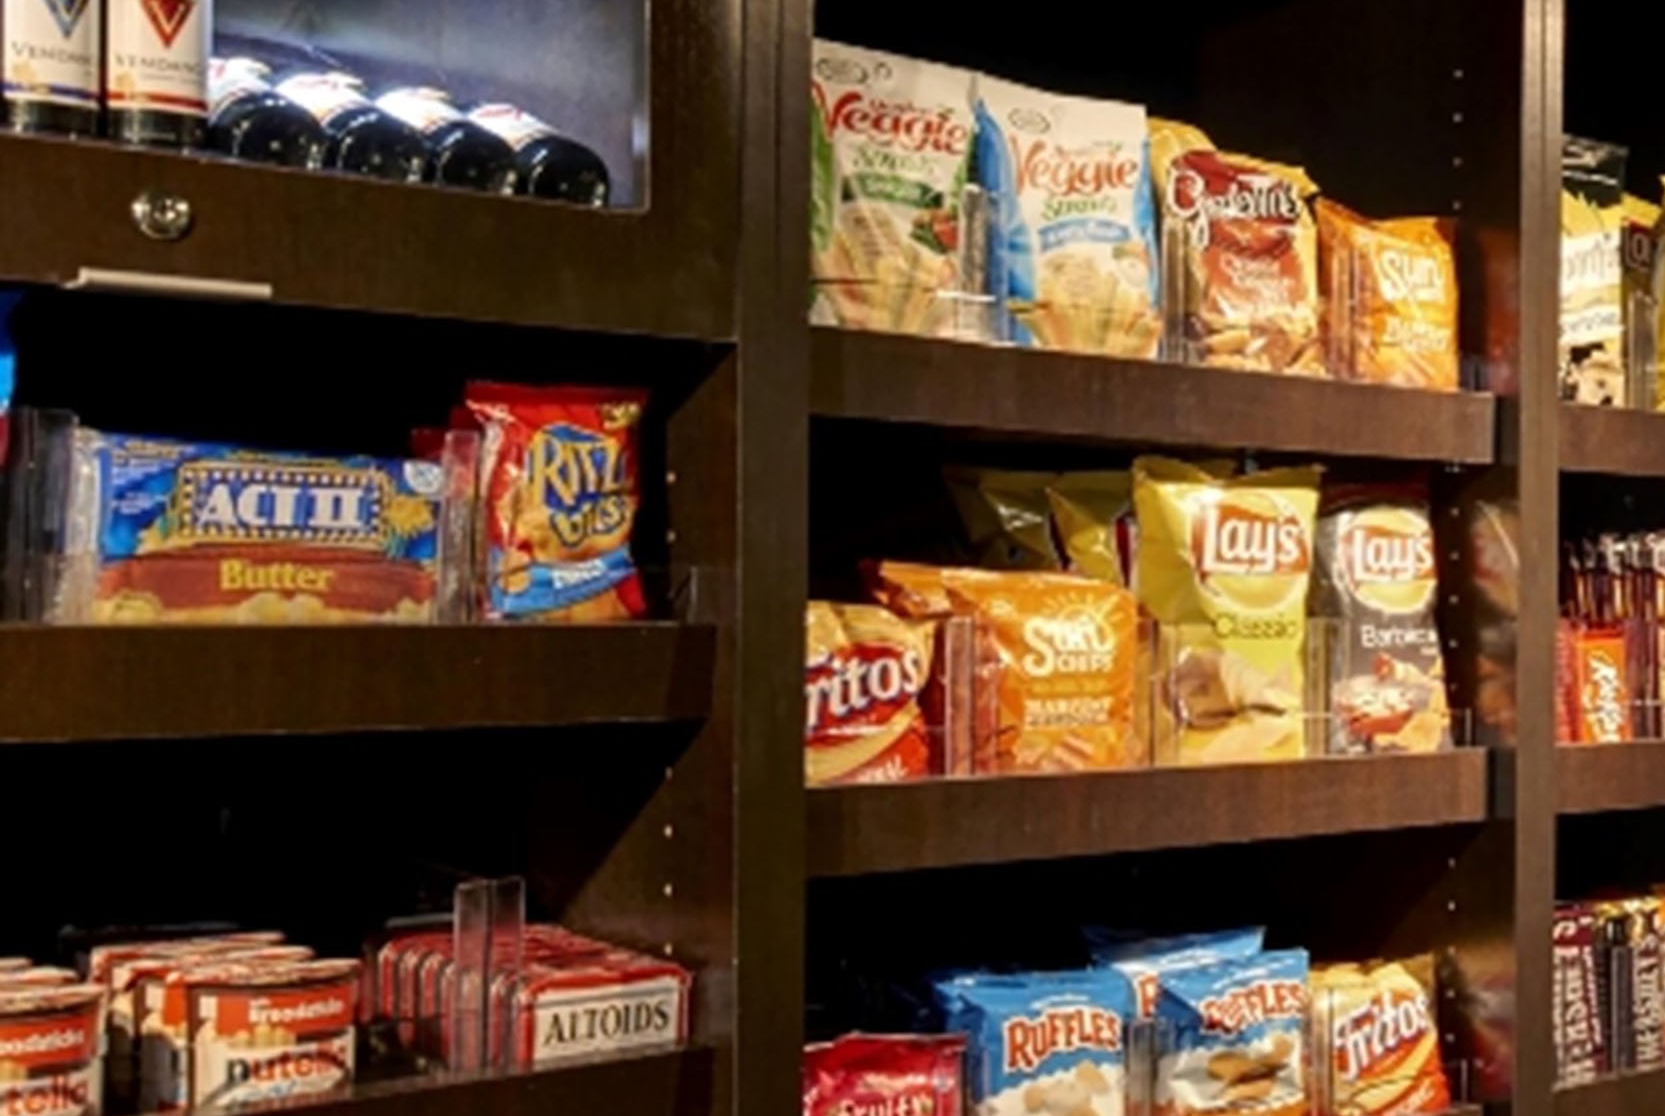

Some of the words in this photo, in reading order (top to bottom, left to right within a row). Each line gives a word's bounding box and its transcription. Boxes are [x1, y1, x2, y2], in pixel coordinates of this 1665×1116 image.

[812, 81, 967, 155] Veggie
[1008, 133, 1138, 197] Veggie
[530, 430, 630, 506] RITZ
[196, 483, 301, 530] ACT
[307, 484, 366, 530] II
[1203, 502, 1303, 575] Lay's
[1354, 526, 1435, 583] Lay's
[219, 558, 336, 592] Butter
[1214, 609, 1297, 640] Classic
[542, 1000, 670, 1045] ALTOIDS
[1202, 981, 1304, 1035] RUFFLES
[1334, 990, 1429, 1081] Fritos
[1006, 1008, 1120, 1070] RUFFLES
